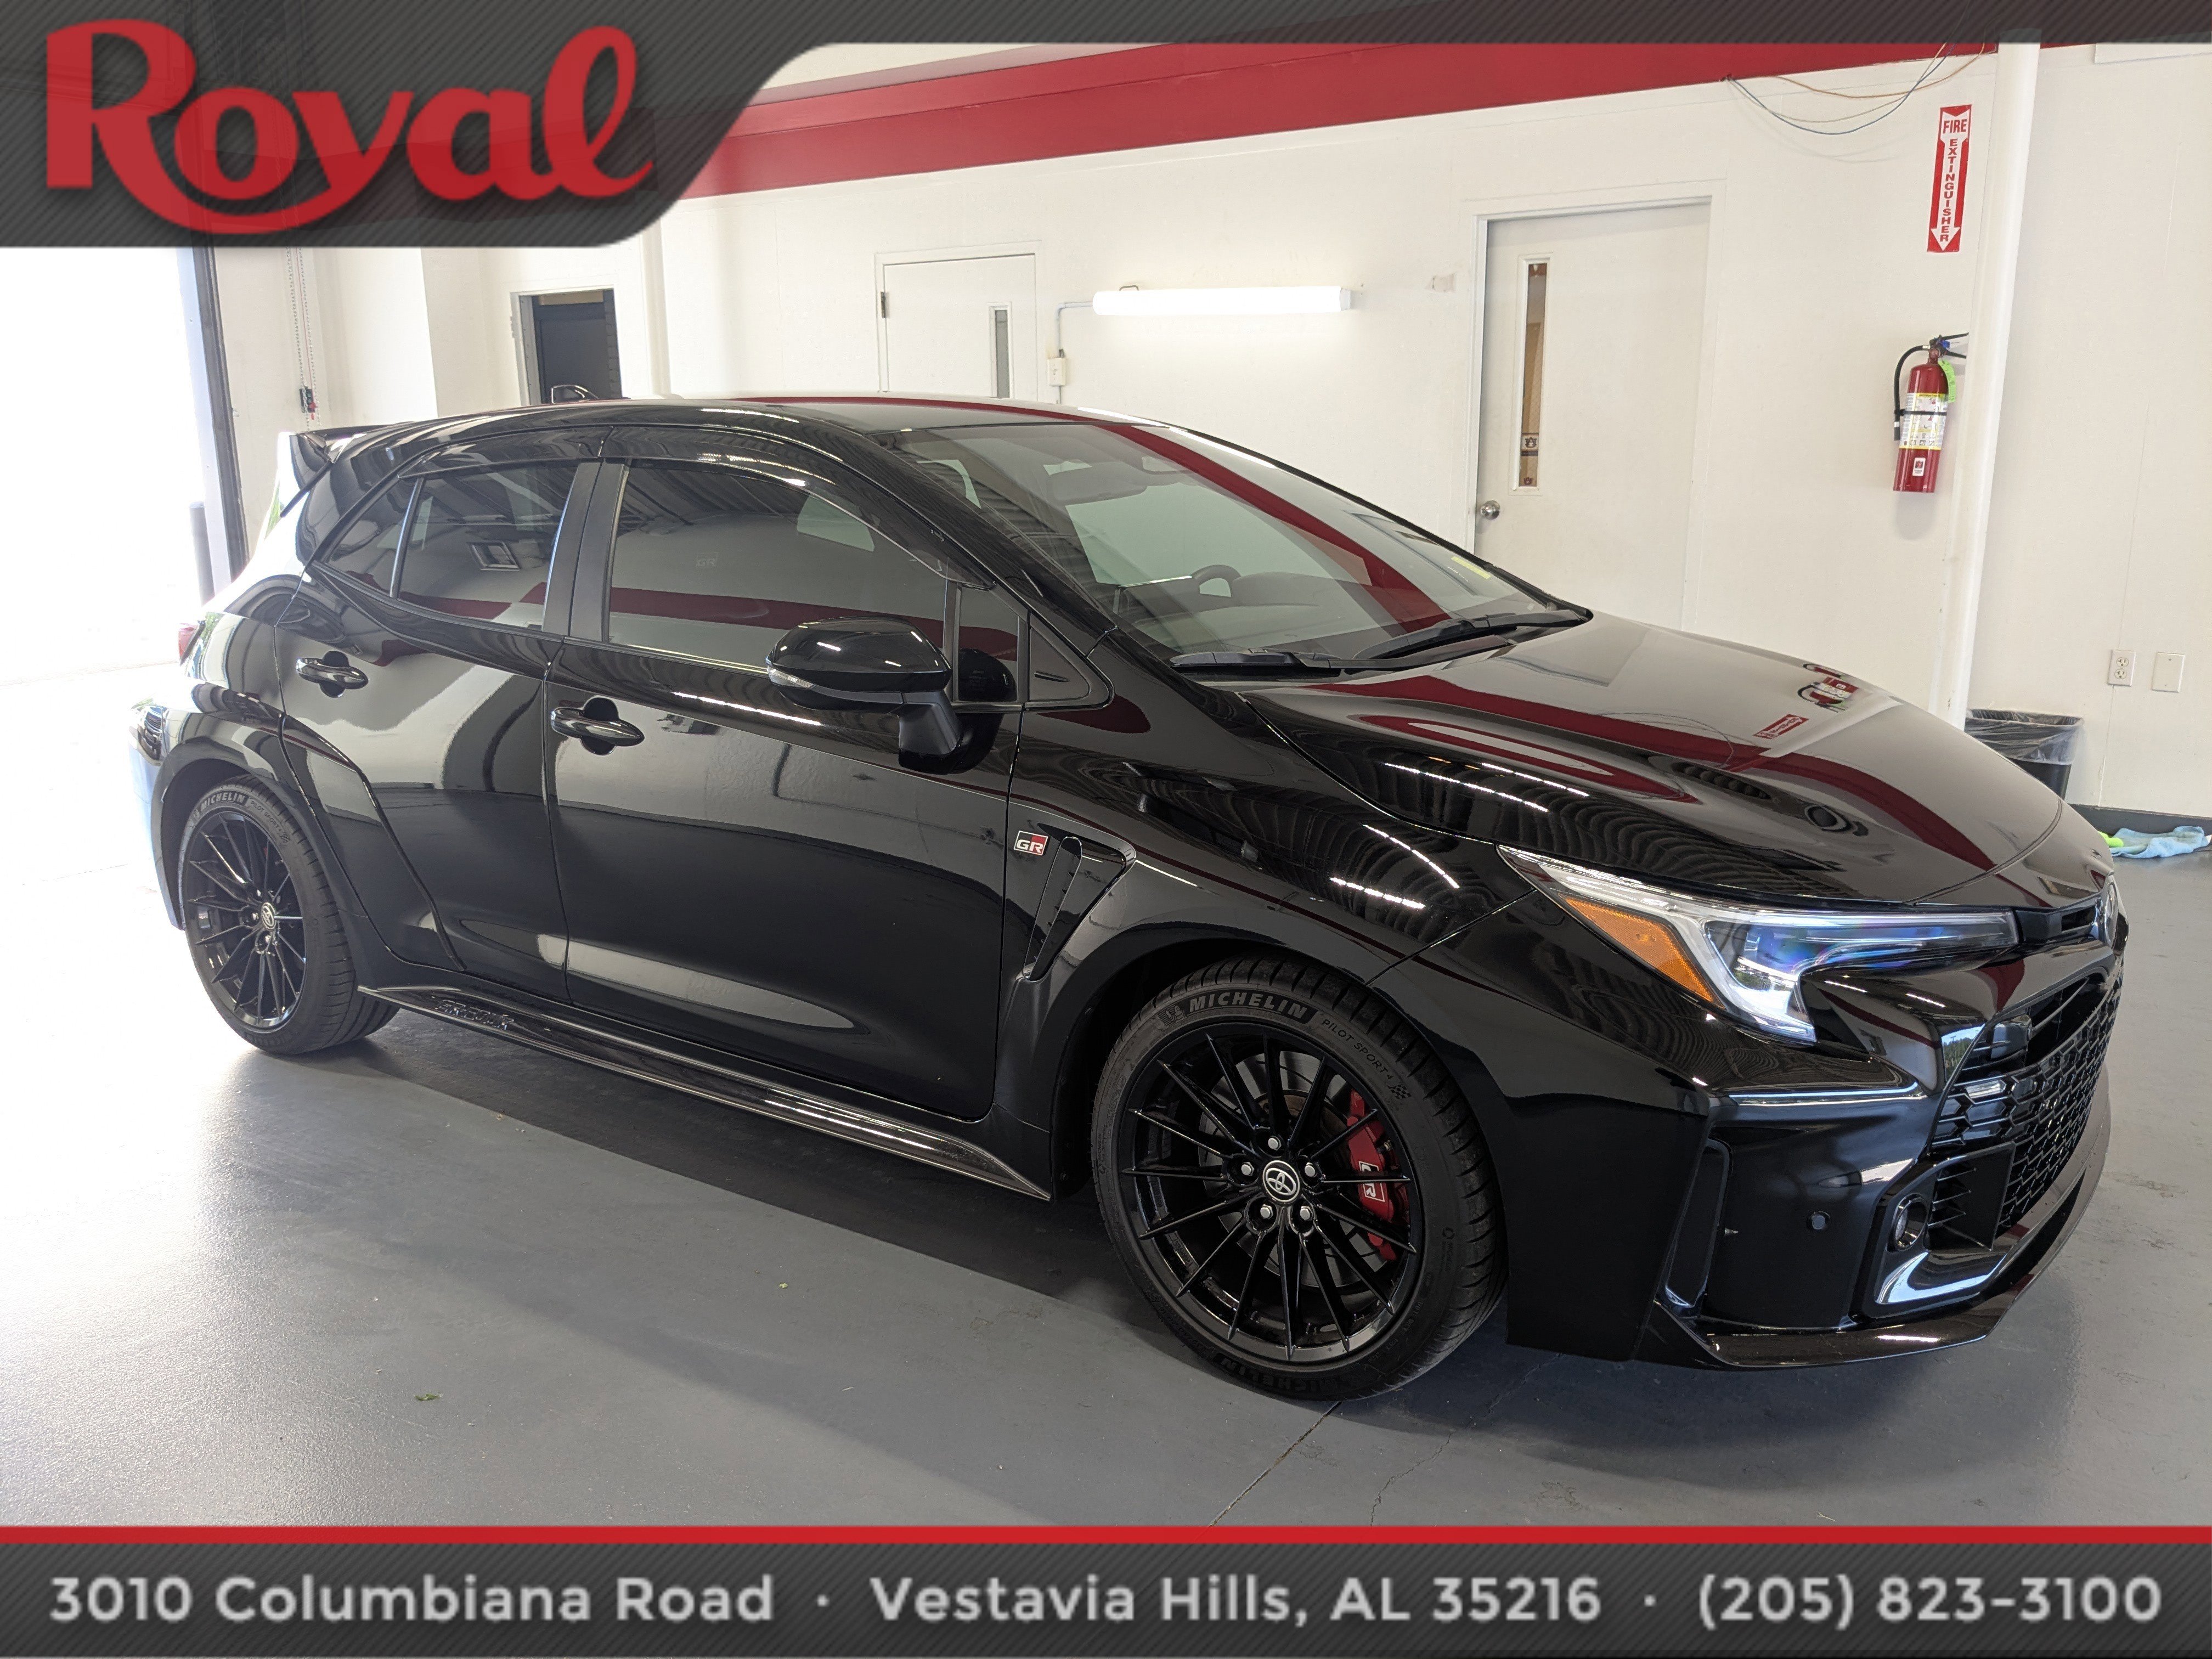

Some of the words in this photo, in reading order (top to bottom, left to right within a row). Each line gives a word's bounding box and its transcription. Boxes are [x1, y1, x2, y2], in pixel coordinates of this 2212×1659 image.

[1943, 119, 1967, 134] FIRE
[1939, 138, 1958, 242] EXTINGUISHER
[201, 792, 245, 811] MICHELIN
[250, 800, 265, 812] PILOT
[264, 812, 279, 829] SPORT
[1016, 839, 1043, 853] GR
[1189, 992, 1308, 1019] MICHELIN
[1321, 1018, 1355, 1041] PILOT
[1353, 1042, 1389, 1074] SPORT
